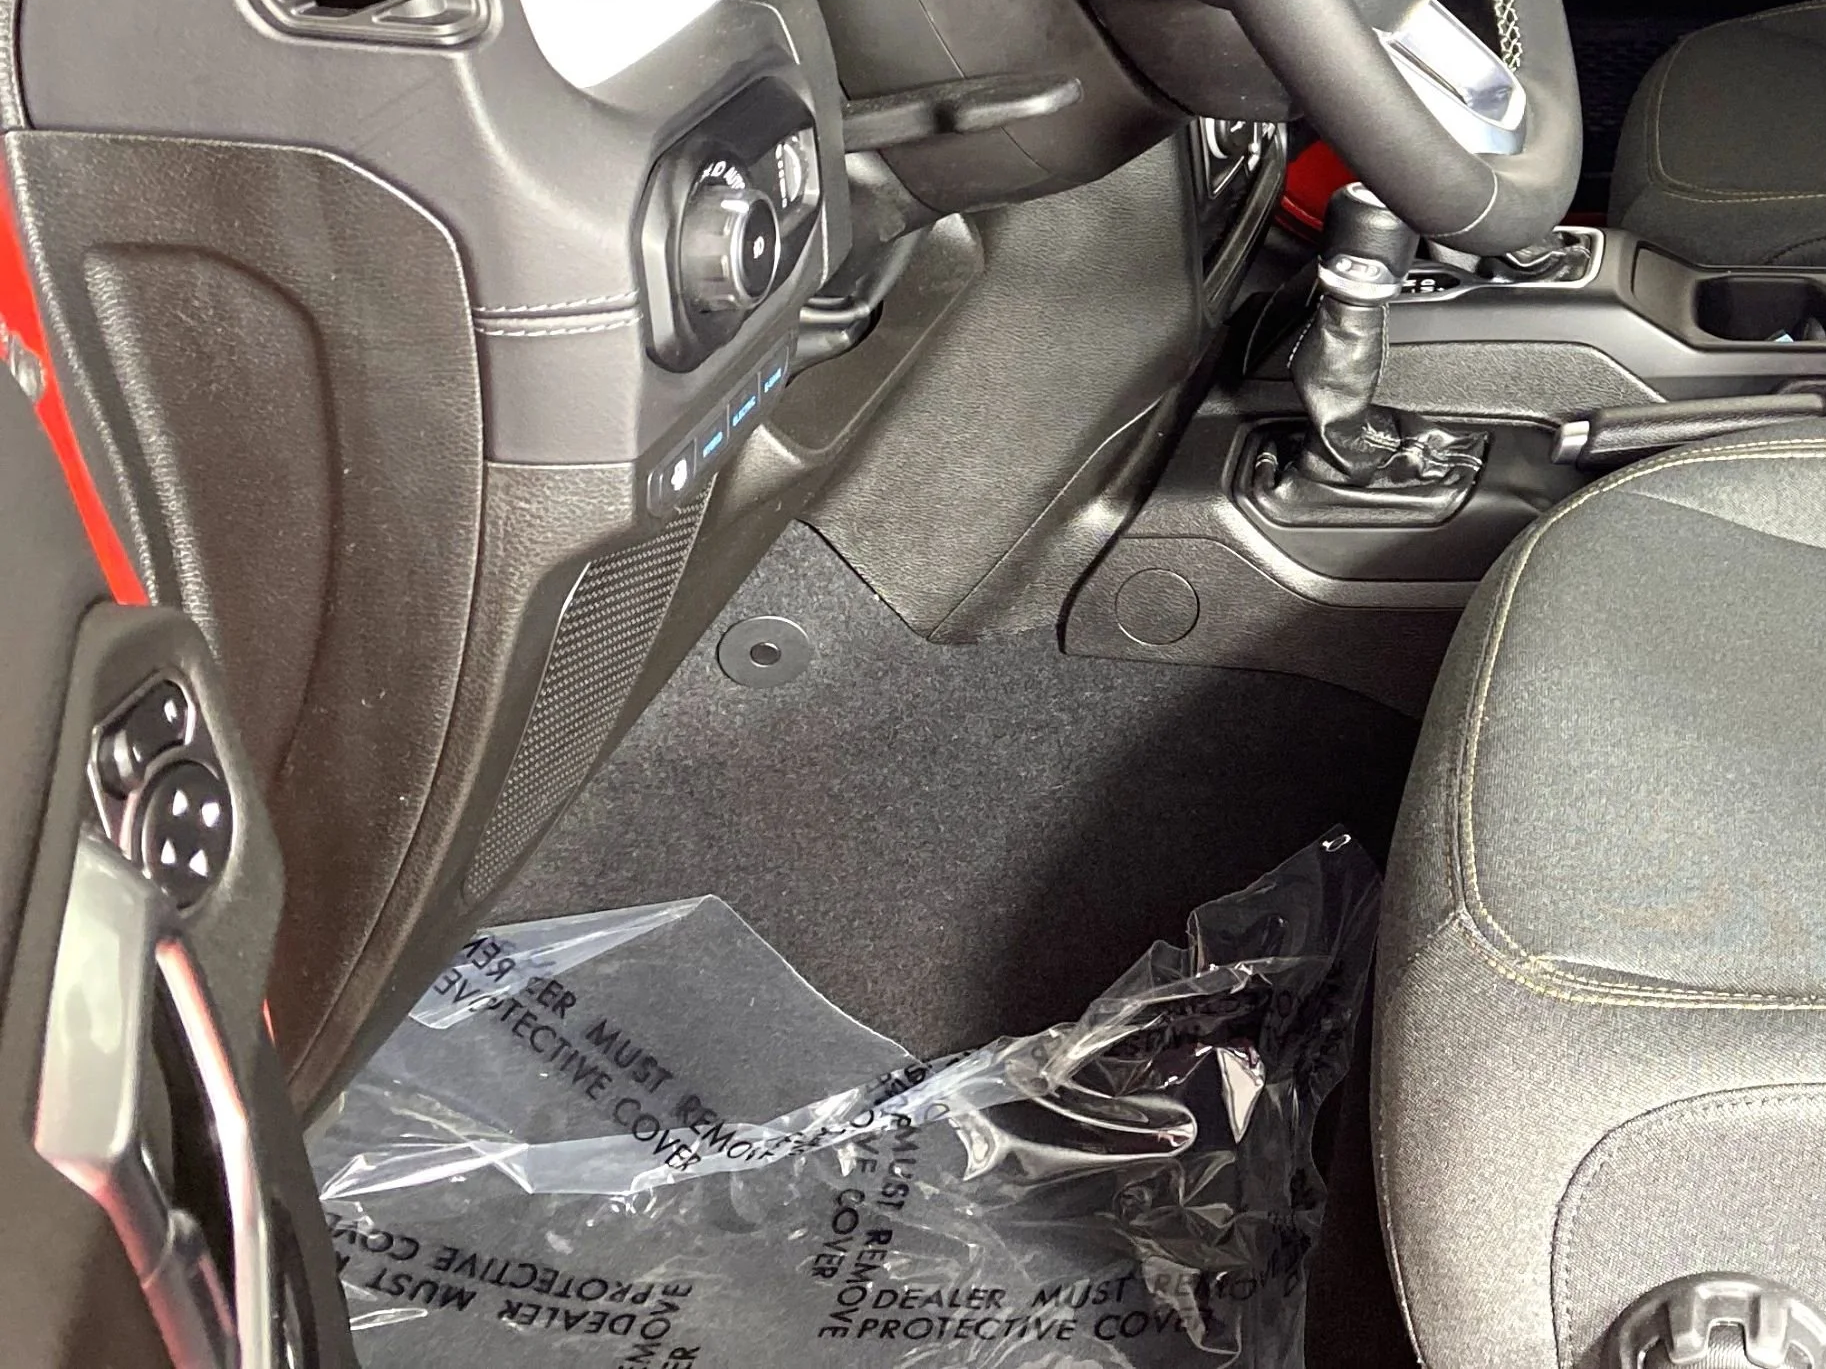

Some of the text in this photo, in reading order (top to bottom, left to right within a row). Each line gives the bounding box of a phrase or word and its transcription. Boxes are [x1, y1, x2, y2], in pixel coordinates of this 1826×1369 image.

[584, 1020, 674, 1095] MUST
[612, 1098, 704, 1172] COVER
[811, 1188, 866, 1280] COVER
[363, 1267, 637, 1338] DEALER MUST
[427, 1245, 655, 1308] PROTECTIVE
[817, 1229, 894, 1339] REMOVE
[872, 1287, 1005, 1311] DEALER
[1030, 1272, 1135, 1309] MUST
[858, 1314, 1077, 1343] PROTECTIVE
